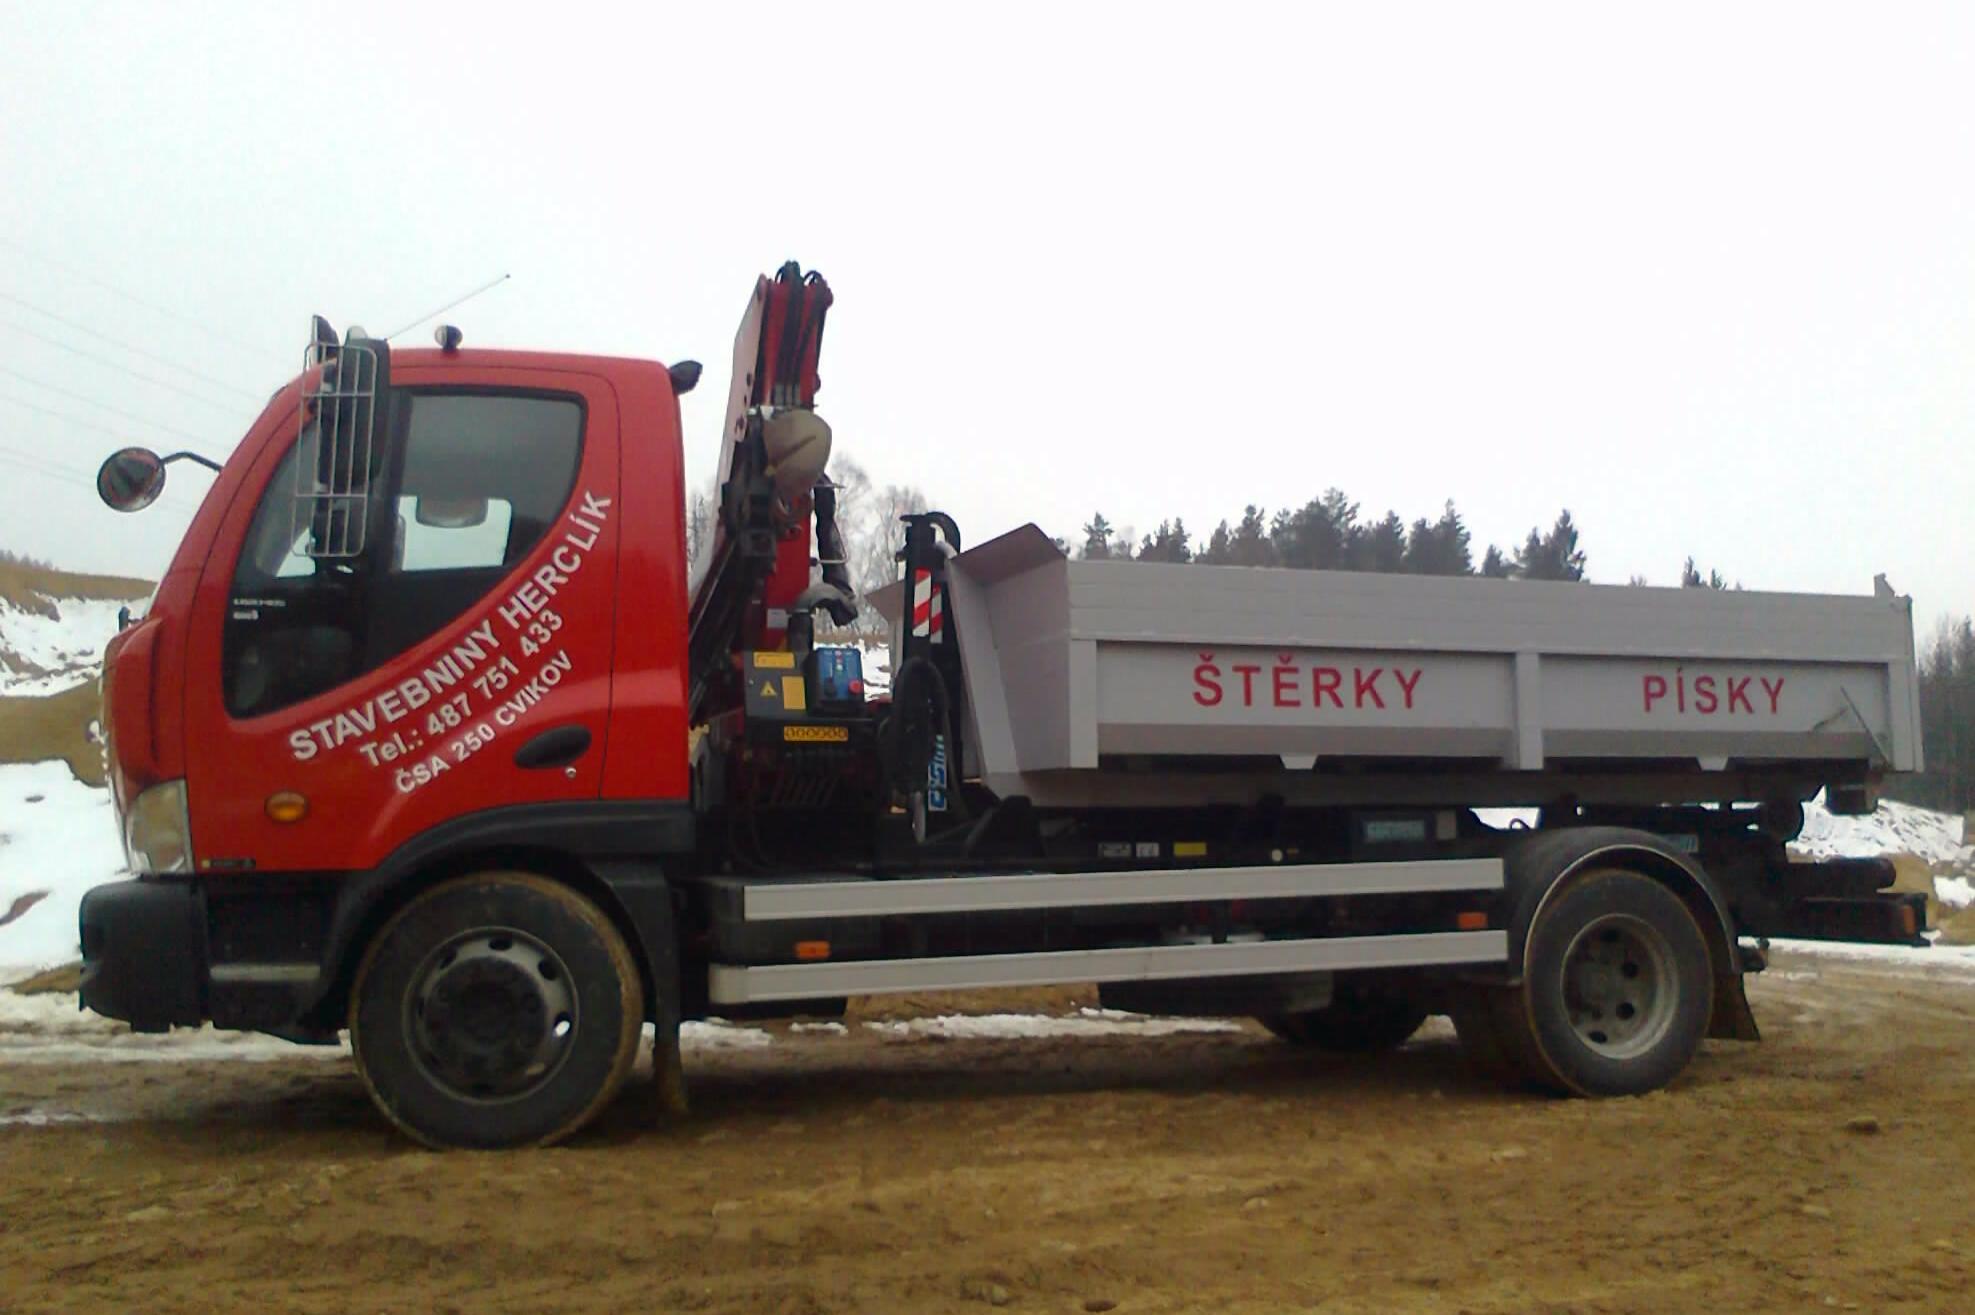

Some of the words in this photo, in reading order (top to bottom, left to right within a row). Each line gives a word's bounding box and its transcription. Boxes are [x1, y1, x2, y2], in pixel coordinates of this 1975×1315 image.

[289, 619, 500, 760] STAVEBNINY
[498, 491, 612, 629] HERCLÍK
[1192, 653, 1422, 709] ŠTĚRKY
[359, 729, 424, 766] Tel.:
[428, 692, 472, 735] 487
[473, 656, 519, 699] 751
[520, 609, 563, 657] 433
[452, 723, 496, 762] 250
[495, 650, 573, 726] CVIKOV
[1643, 666, 1785, 714] PÍSKY
